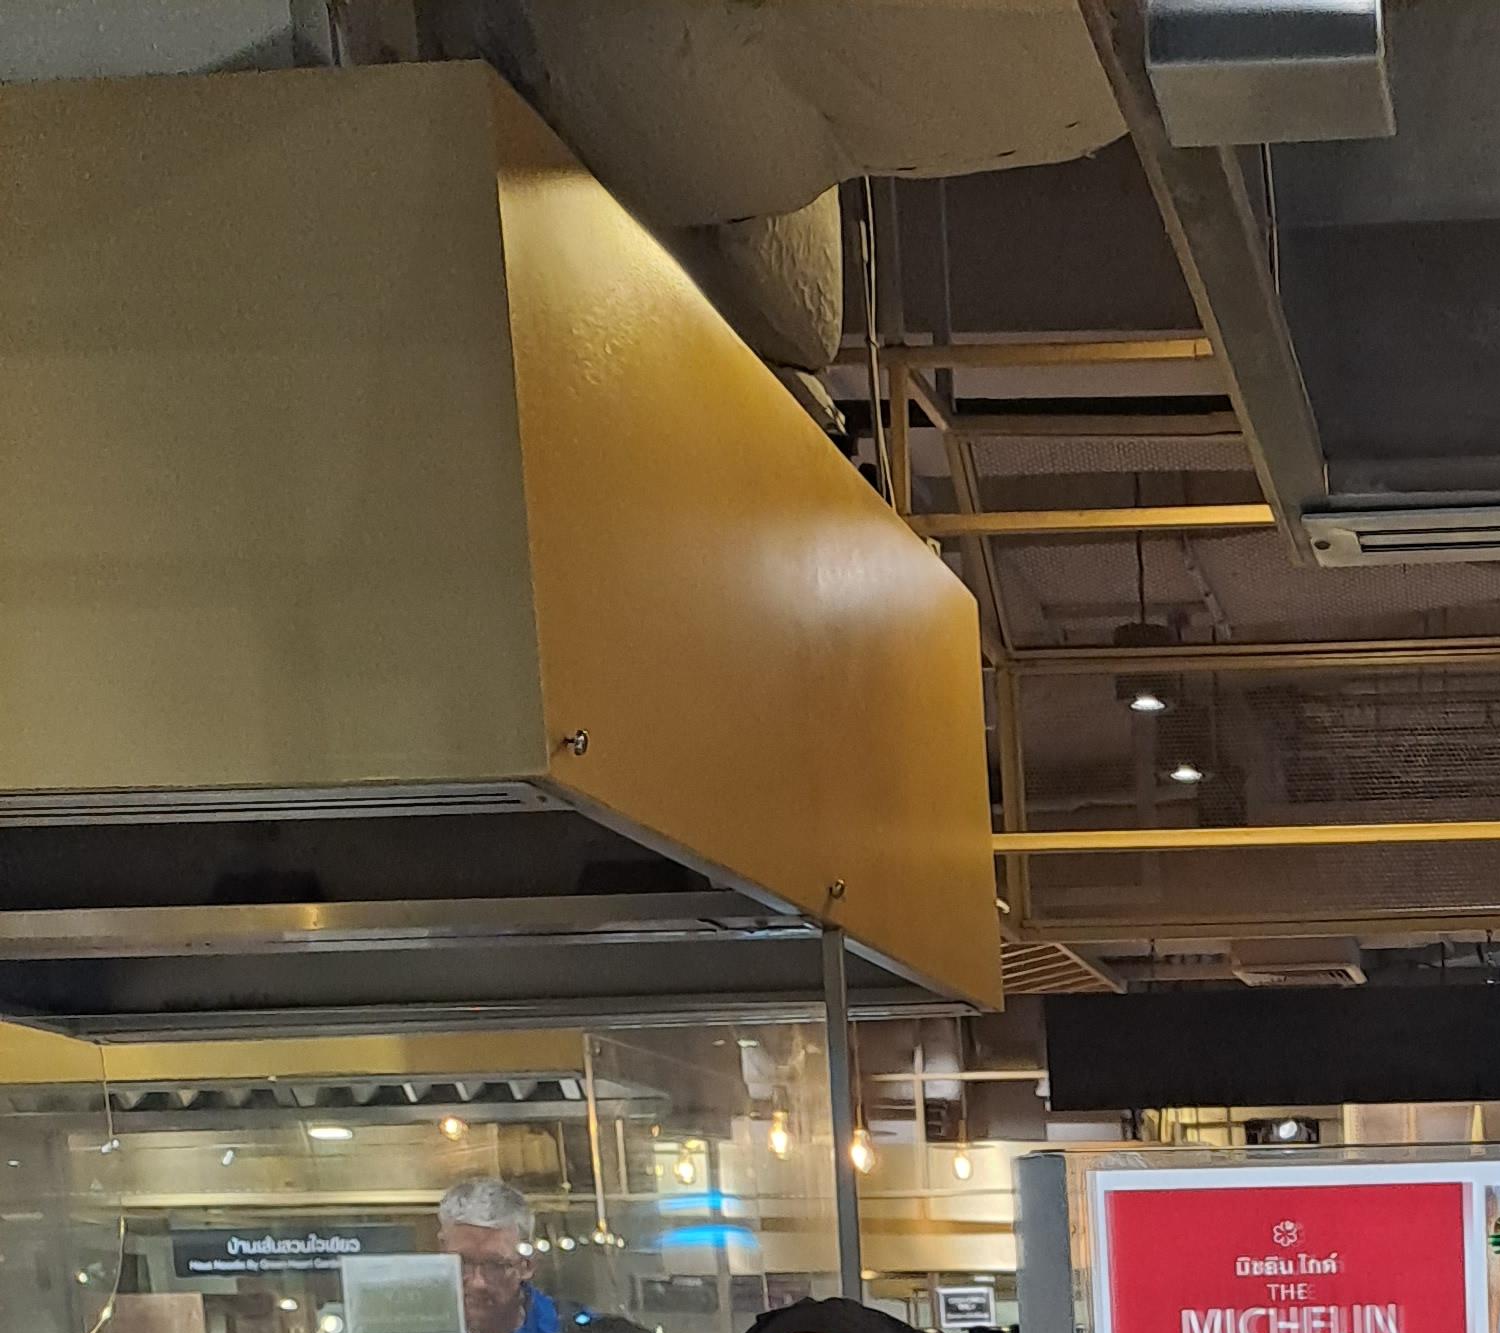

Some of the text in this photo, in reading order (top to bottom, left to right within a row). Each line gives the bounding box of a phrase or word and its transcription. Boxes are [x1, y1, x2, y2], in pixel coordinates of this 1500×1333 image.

[1236, 1252, 1340, 1276] มิชลิน ไกด์
[1267, 1283, 1309, 1301] THE
